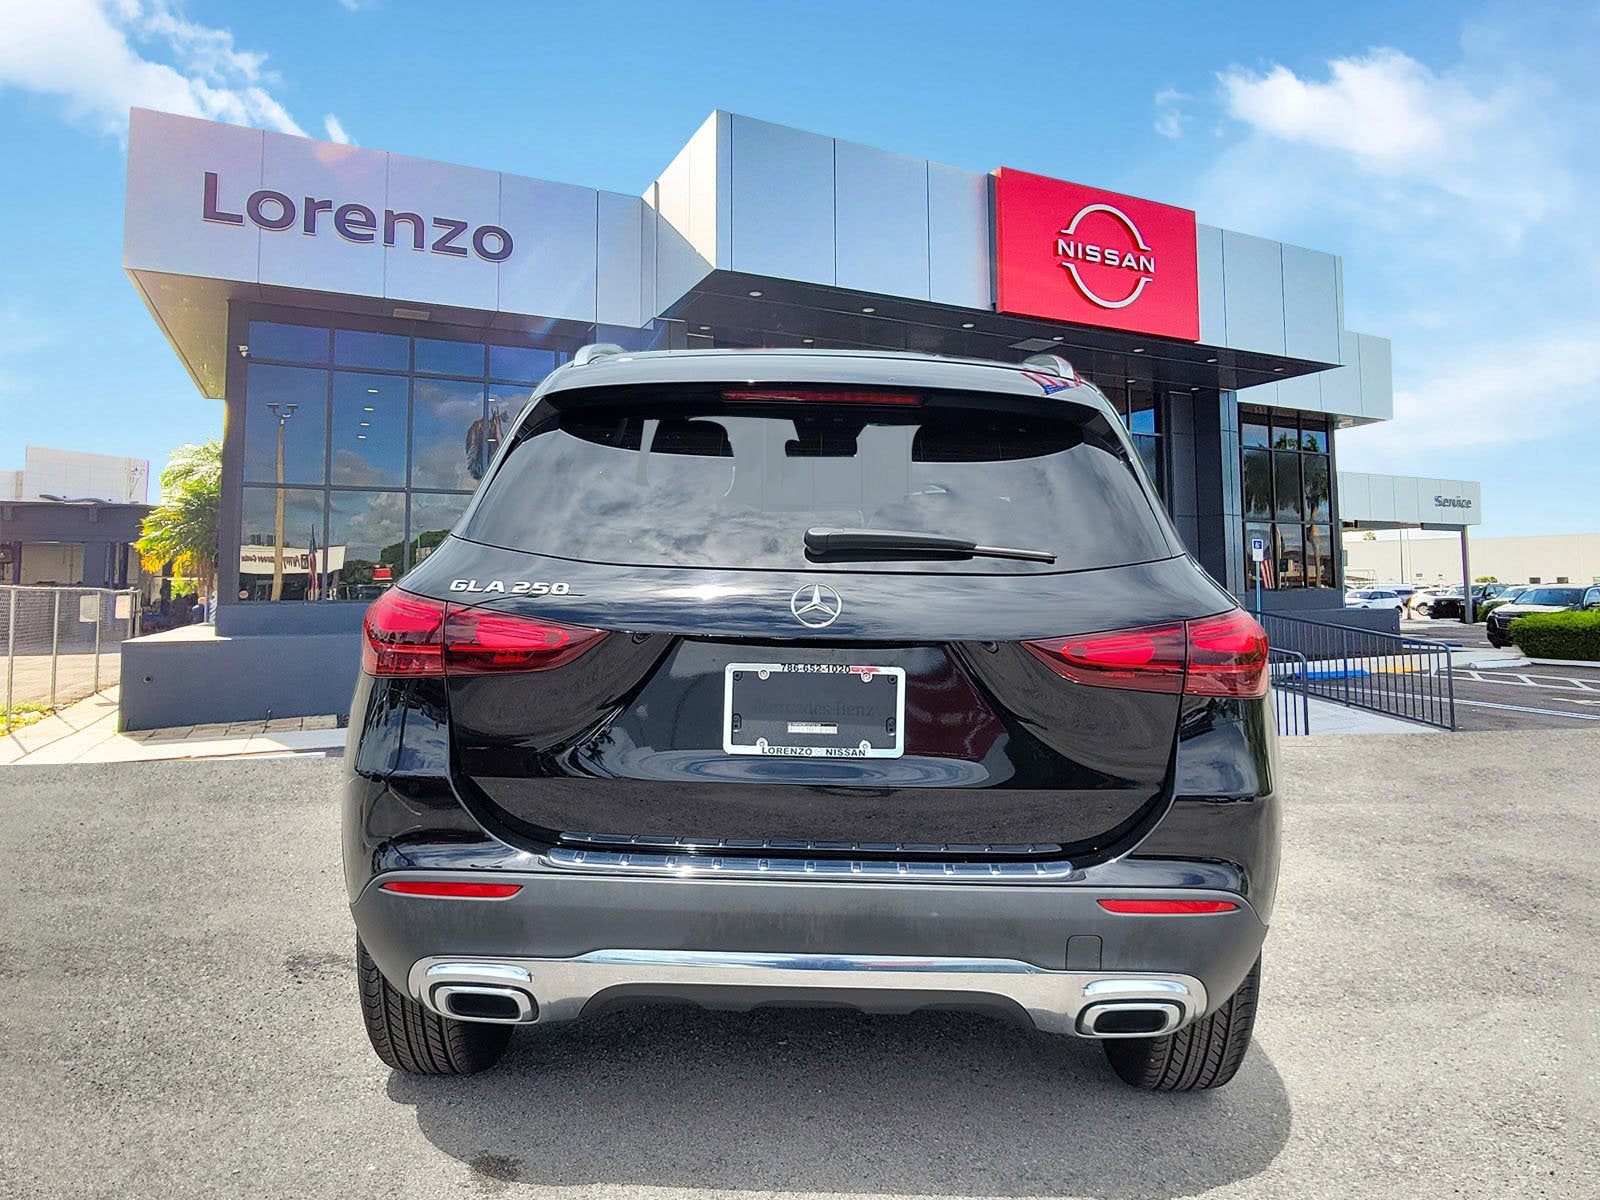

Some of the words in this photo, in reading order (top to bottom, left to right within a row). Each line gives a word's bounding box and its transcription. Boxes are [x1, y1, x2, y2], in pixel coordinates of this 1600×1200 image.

[203, 171, 514, 262] Lorenzo
[1057, 238, 1155, 273] NISSAN
[1434, 495, 1472, 508] Service
[450, 579, 505, 593] GLA
[510, 581, 570, 595] 250
[781, 663, 851, 674] 786-652-1020
[761, 746, 813, 756] LORENZO
[825, 748, 866, 757] NISSAN
